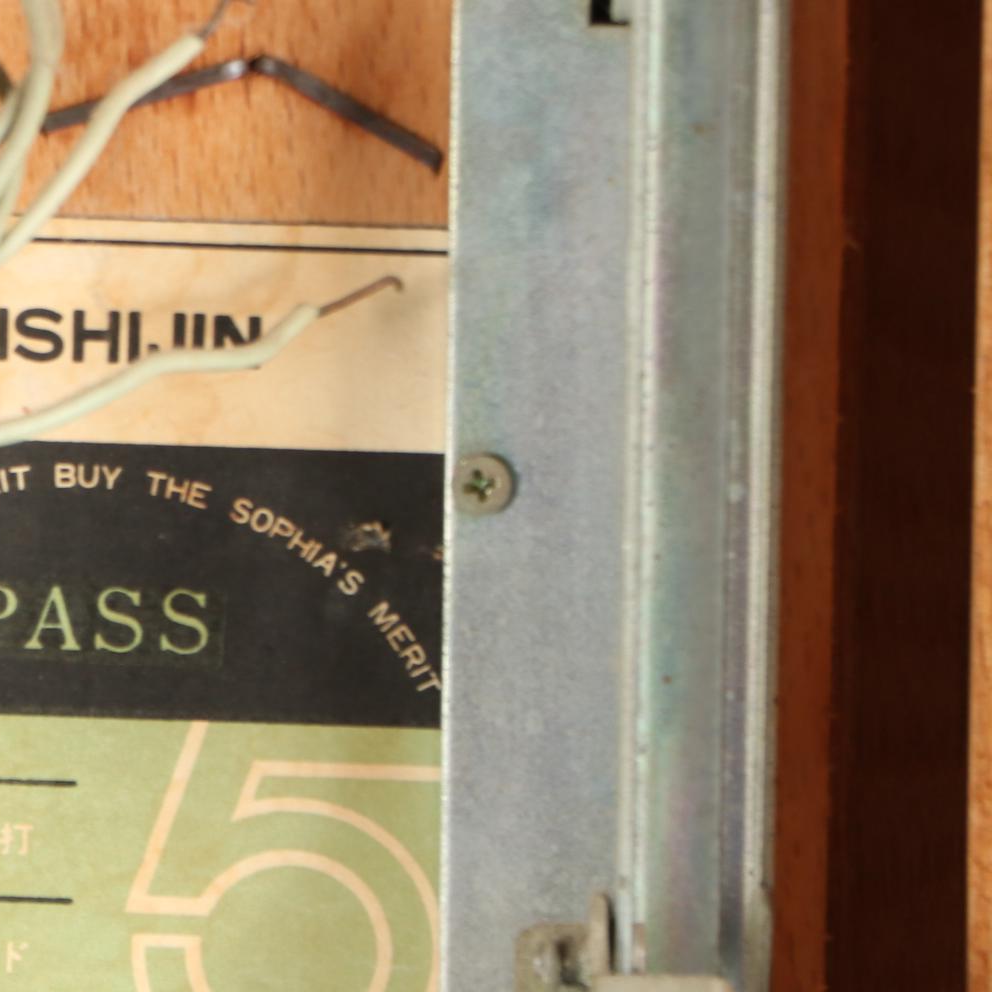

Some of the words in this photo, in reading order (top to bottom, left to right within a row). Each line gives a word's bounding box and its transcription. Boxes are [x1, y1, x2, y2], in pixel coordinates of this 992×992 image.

[54, 462, 123, 490] BUY
[146, 470, 213, 510] THE
[229, 497, 365, 596] SOPHIA'S
[368, 601, 442, 692] MERIT
